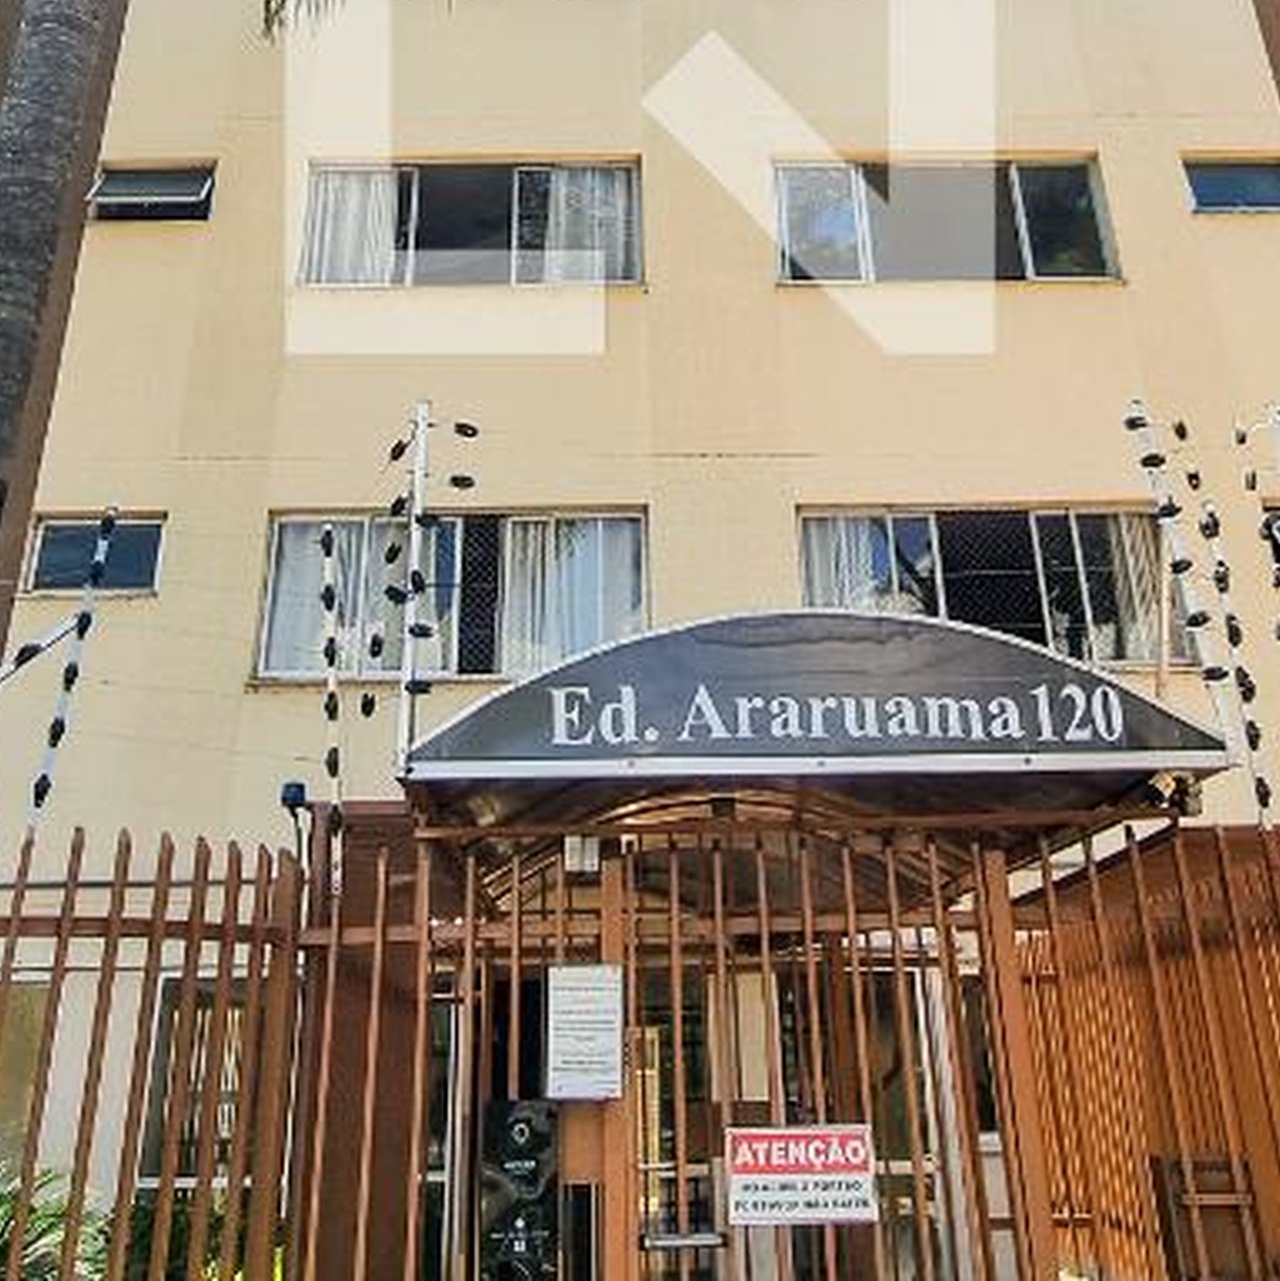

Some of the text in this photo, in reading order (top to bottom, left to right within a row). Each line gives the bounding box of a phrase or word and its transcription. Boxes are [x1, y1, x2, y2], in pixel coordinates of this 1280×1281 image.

[547, 682, 1125, 746] Ed. Araruama 120
[734, 1136, 866, 1169] ATENÇÃO
